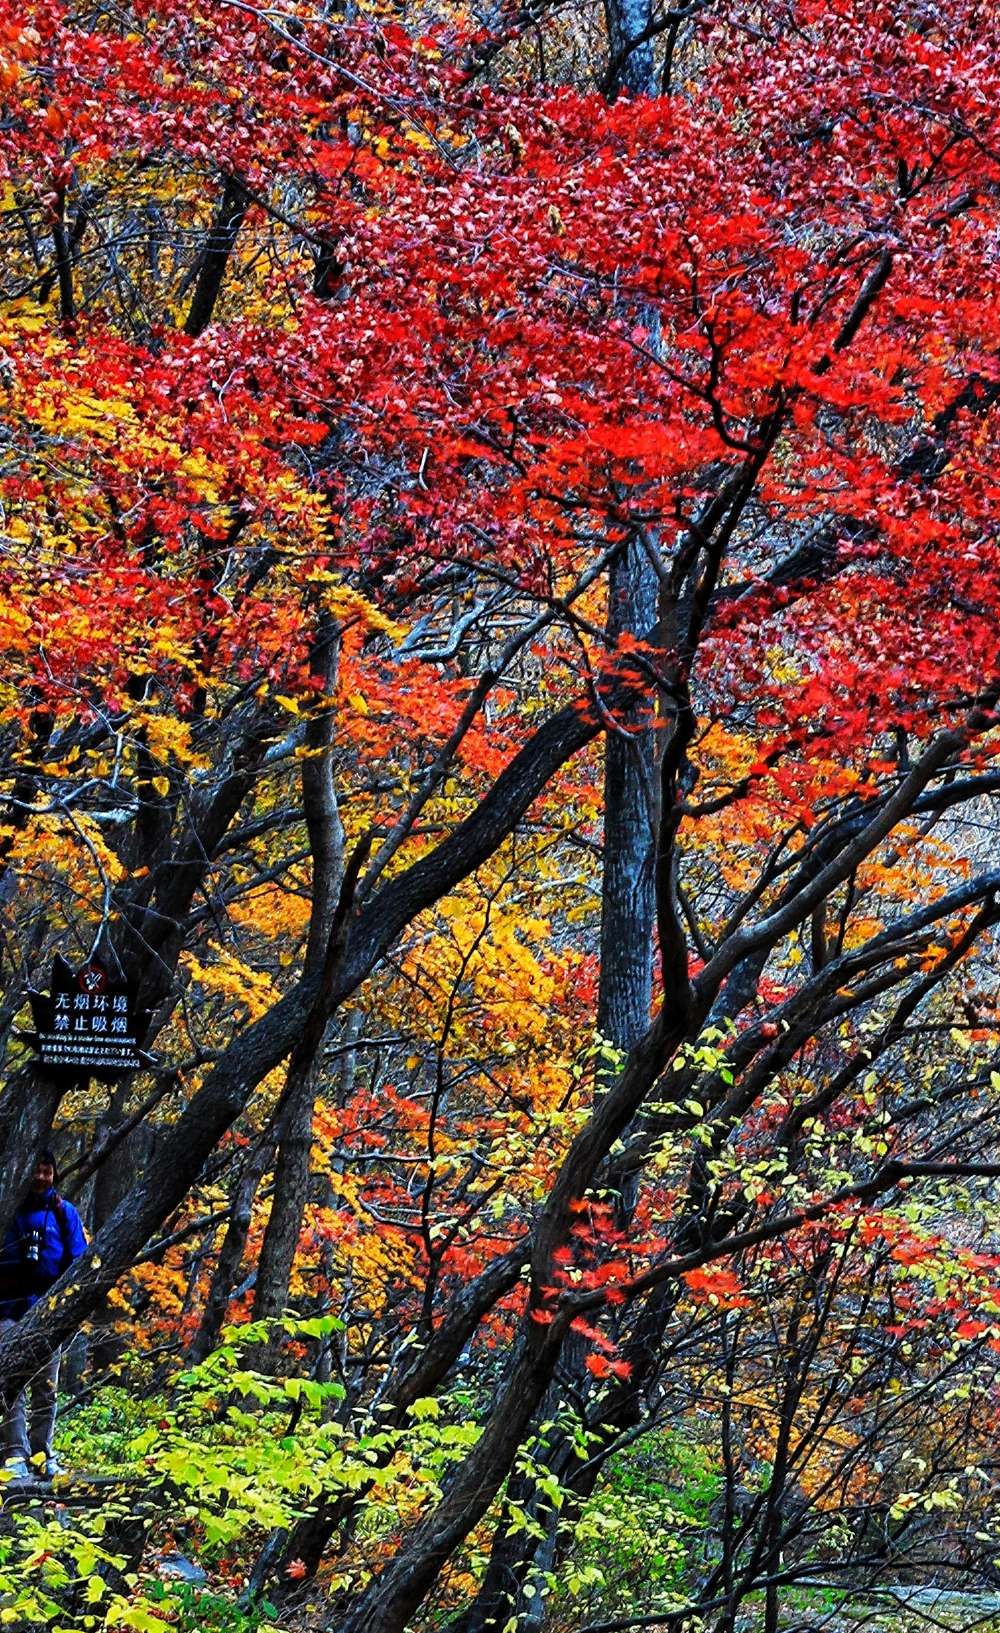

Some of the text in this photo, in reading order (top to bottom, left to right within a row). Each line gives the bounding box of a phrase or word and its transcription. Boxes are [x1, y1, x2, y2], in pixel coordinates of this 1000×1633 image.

[55, 993, 128, 1012] 无烟环境
[54, 1014, 127, 1033] 禁止吸烟
